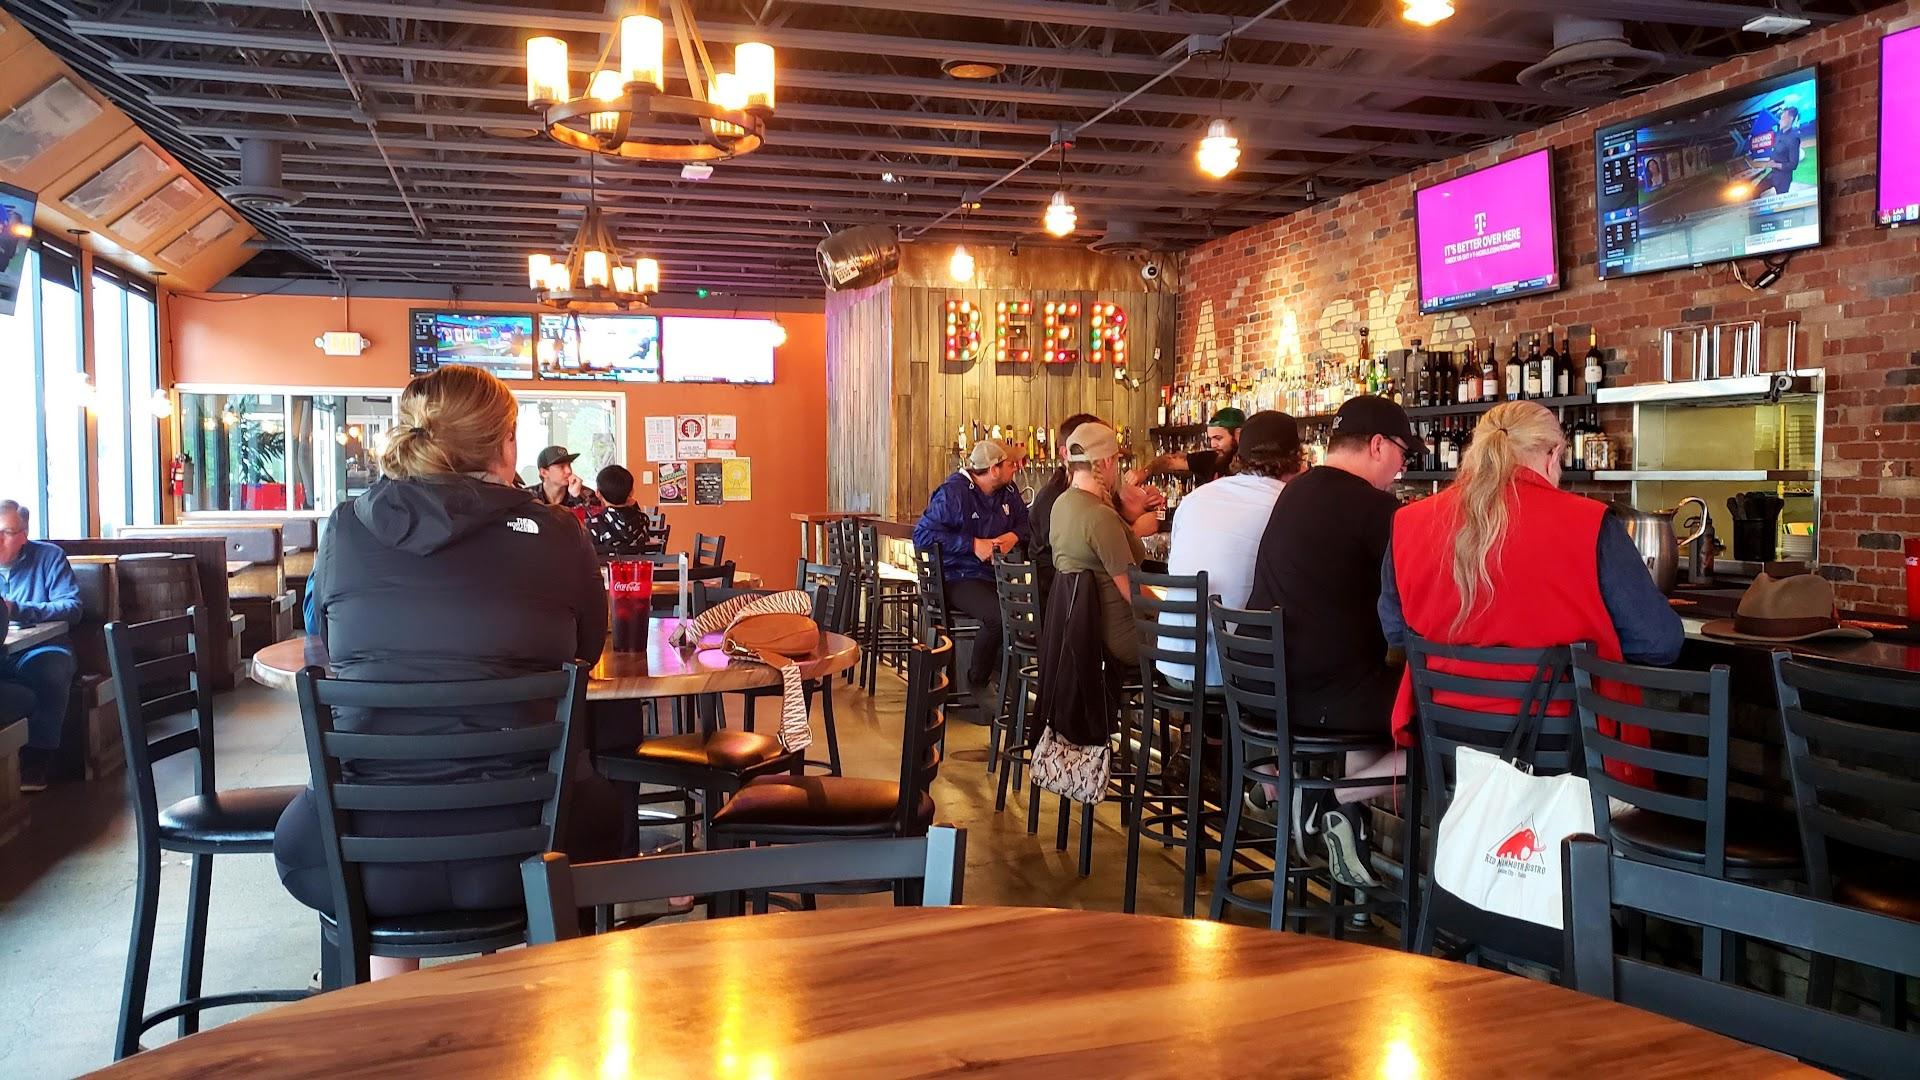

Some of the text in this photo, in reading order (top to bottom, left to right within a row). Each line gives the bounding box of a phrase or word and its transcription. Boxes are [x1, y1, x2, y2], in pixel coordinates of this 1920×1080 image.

[1444, 227, 1521, 257] IT'S BETTER OVER HERE
[944, 299, 1129, 367] BEER
[507, 521, 528, 529] NORTH
[614, 581, 641, 592] Coca-Cola
[1484, 852, 1496, 865] RED
[1496, 858, 1525, 872] MAMMOTH
[1524, 862, 1546, 875] BISTRO
